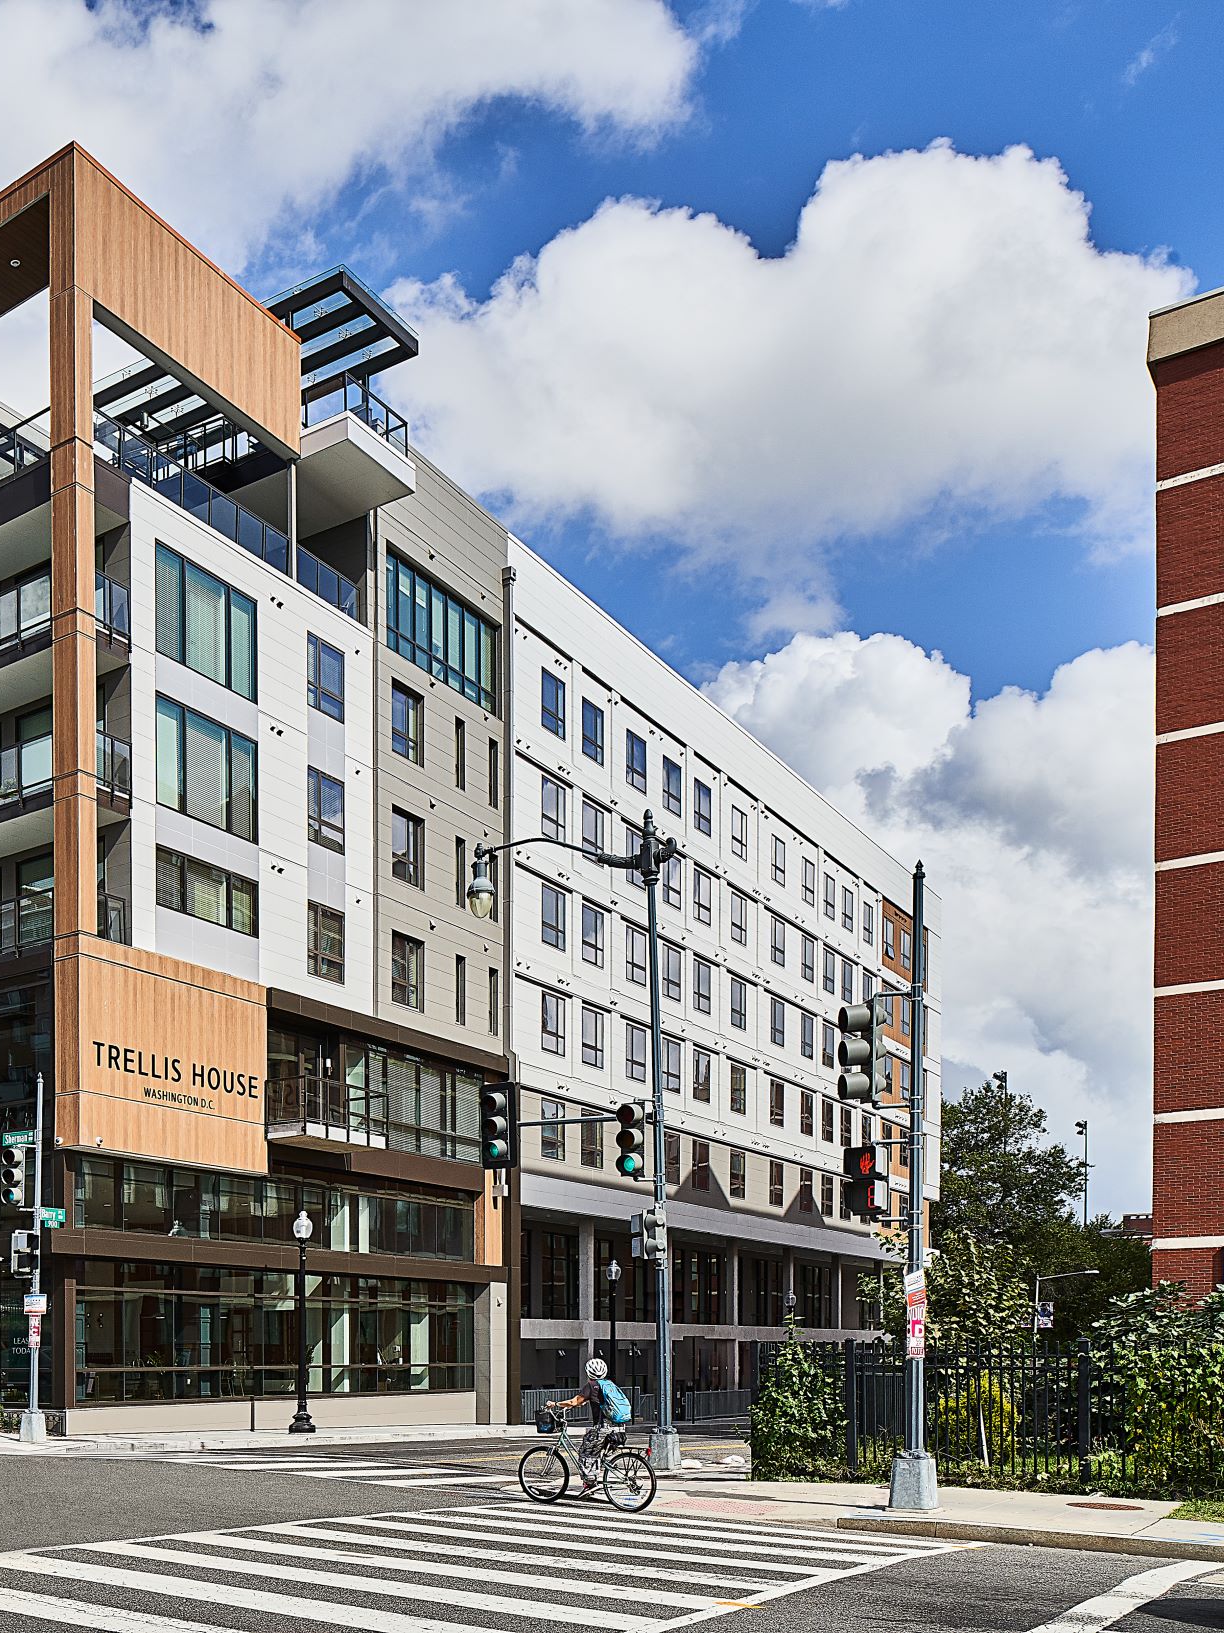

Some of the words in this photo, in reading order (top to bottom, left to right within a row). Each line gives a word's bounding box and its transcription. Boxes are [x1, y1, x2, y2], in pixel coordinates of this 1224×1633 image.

[92, 1040, 182, 1083] TRELLIS
[192, 1062, 259, 1099] HOUSE
[143, 1086, 199, 1107] WASHINGTON
[200, 1098, 215, 1110] D.C.
[4, 1134, 28, 1144] Sherman
[13, 1337, 30, 1345] LEAS
[11, 1347, 31, 1355] TODA
